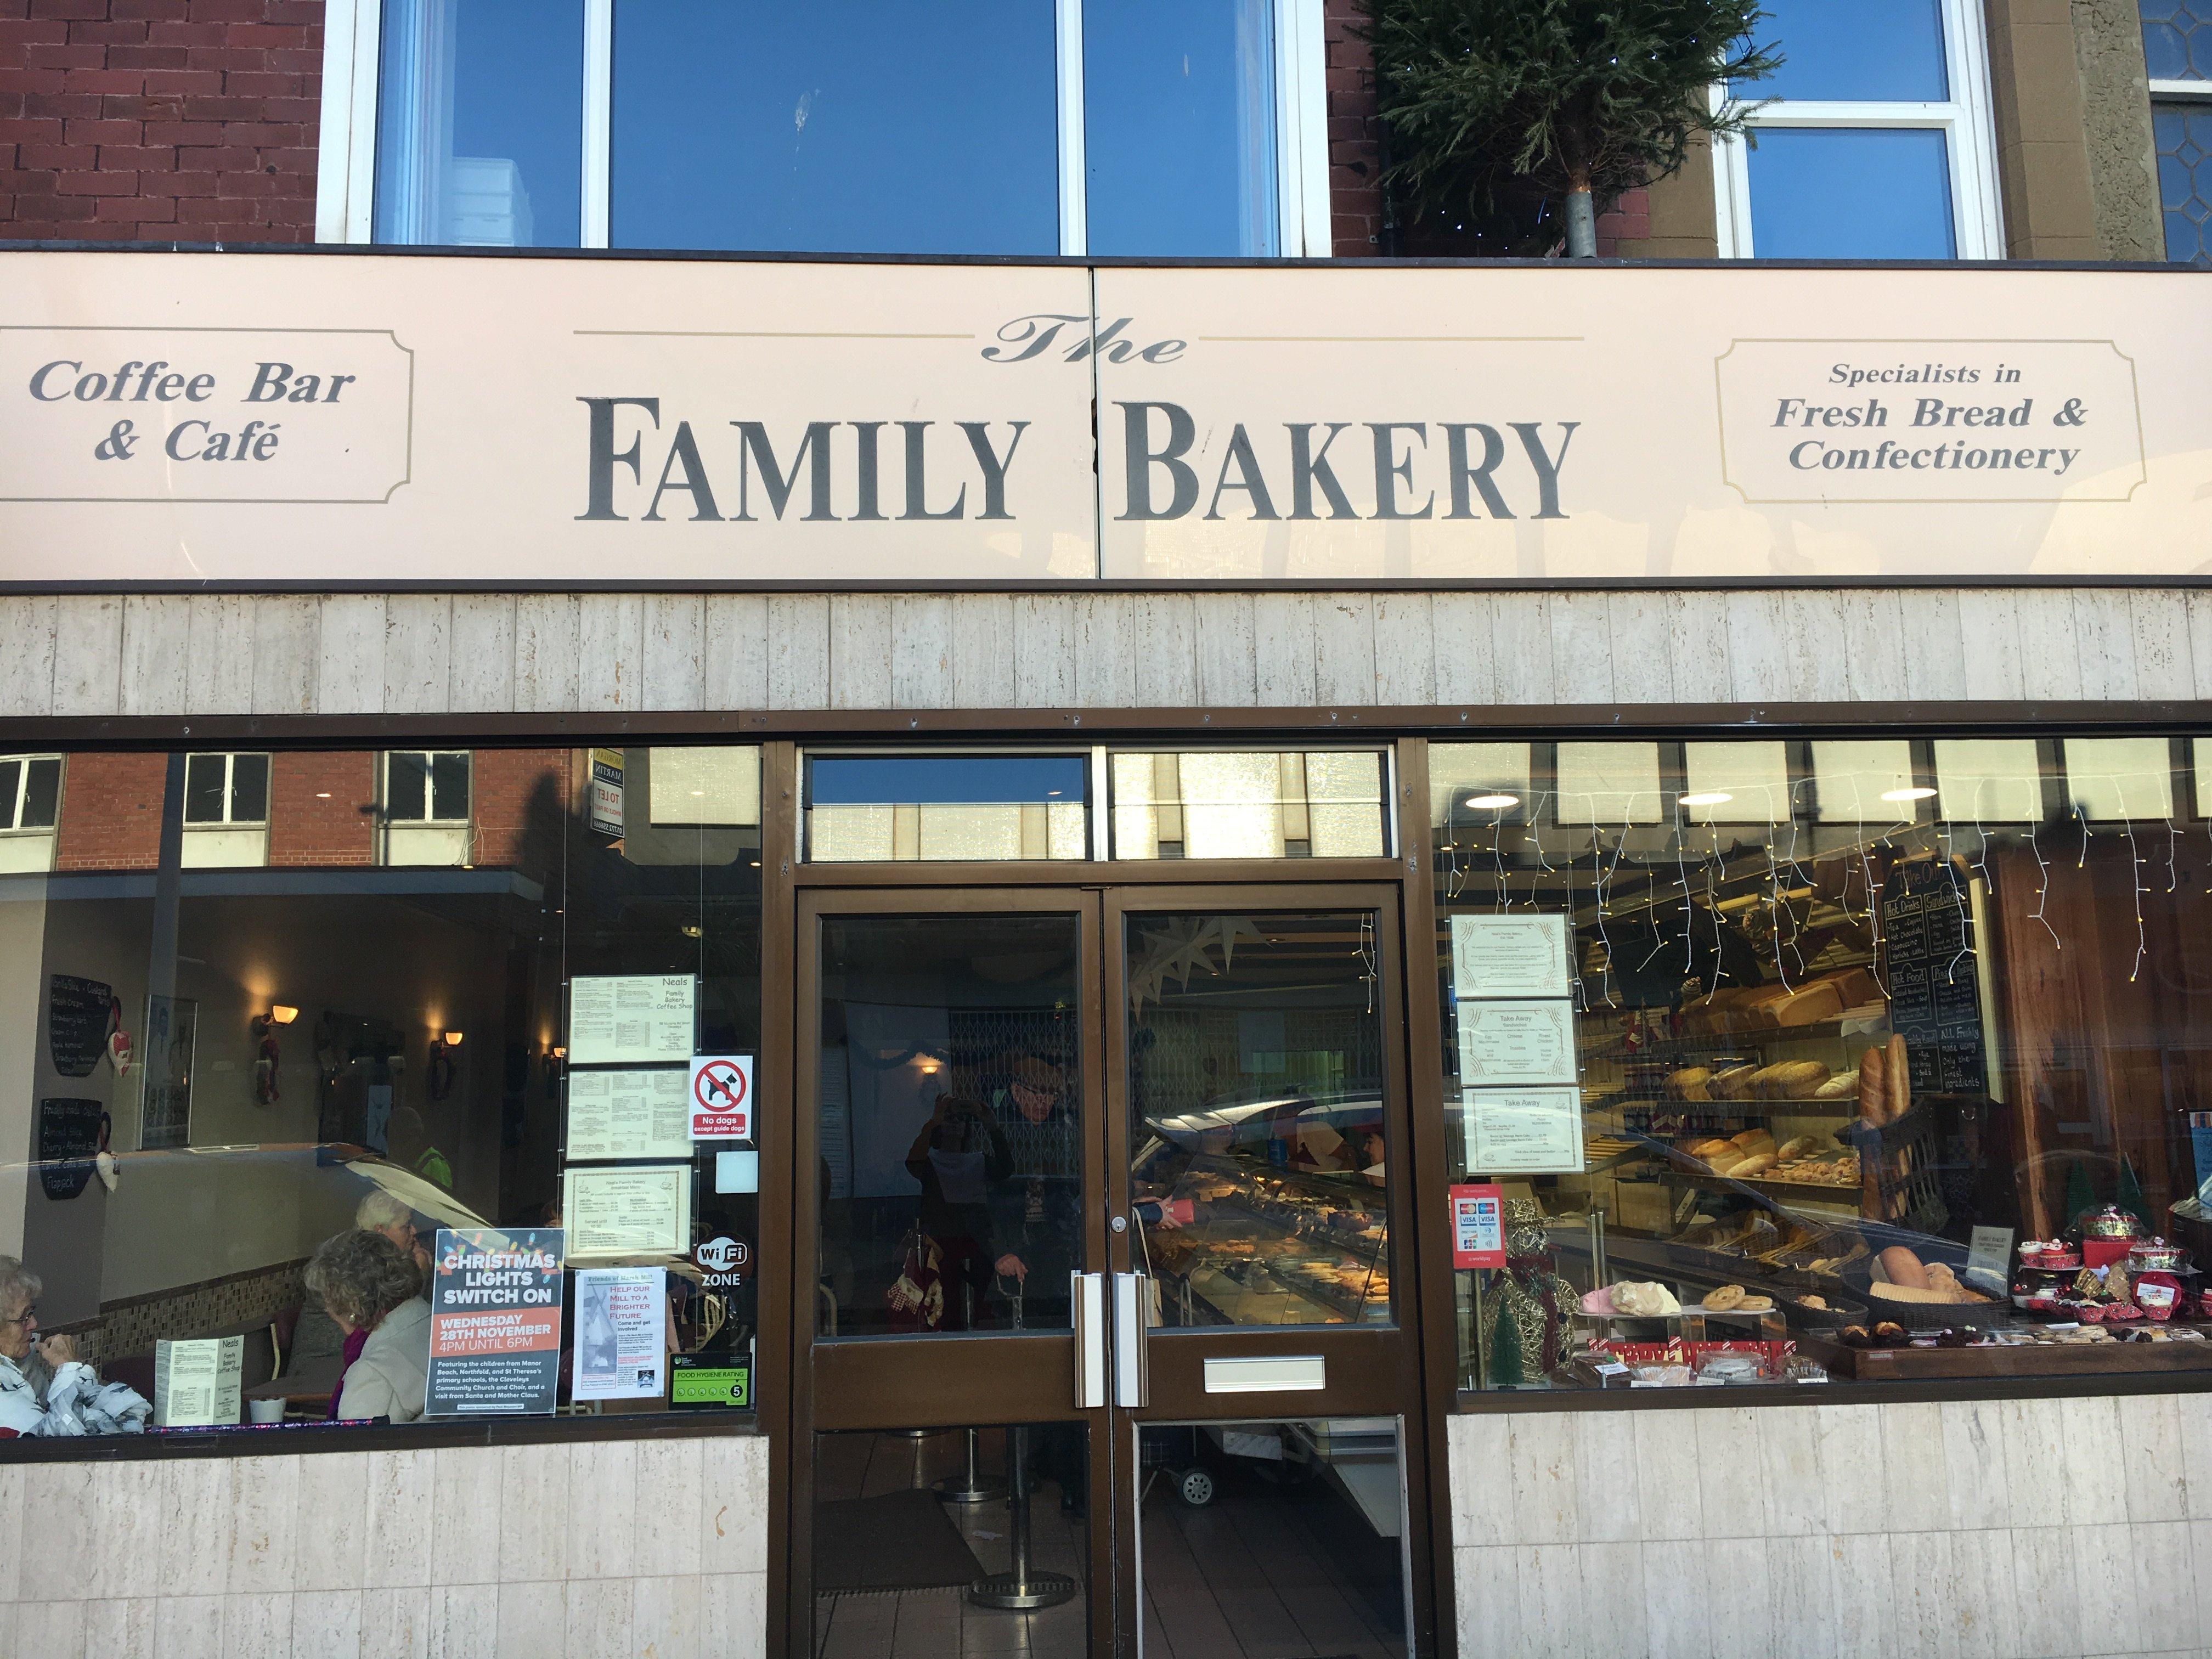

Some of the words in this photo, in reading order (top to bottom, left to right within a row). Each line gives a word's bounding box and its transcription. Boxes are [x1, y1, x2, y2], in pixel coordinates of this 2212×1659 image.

[981, 314, 1187, 364] The
[29, 360, 215, 402] Coffee
[240, 362, 355, 403] Bar
[1829, 363, 1980, 387] Specialists
[1994, 364, 2022, 383] in
[1770, 398, 1889, 427] Fresh
[1909, 398, 2033, 427] Bread
[2053, 398, 2088, 427] &
[94, 419, 140, 460] &
[165, 419, 281, 462] Café
[573, 396, 1031, 521] FAMILY
[1111, 400, 1581, 520] BAKERY
[1790, 440, 2081, 476] Confectionery
[1887, 904, 1900, 917] Hot
[1901, 900, 1920, 912] Drinks
[663, 978, 687, 986] Neals
[1906, 969, 1925, 982] Food
[716, 1116, 737, 1125] dogs
[444, 1254, 555, 1269] CHRISTMAS
[465, 1272, 533, 1286] LIGHTS
[702, 1274, 740, 1286] ZONE
[443, 1289, 518, 1305] SWITCH
[523, 1289, 551, 1304] ON
[440, 1314, 523, 1329] WEDNESDAY
[440, 1329, 473, 1341] 28TH
[477, 1324, 551, 1338] NOVEMBER
[439, 1341, 465, 1352] 4PM
[469, 1339, 503, 1351] UNTIL
[507, 1336, 533, 1348] 6PM
[733, 1386, 740, 1396] 5
